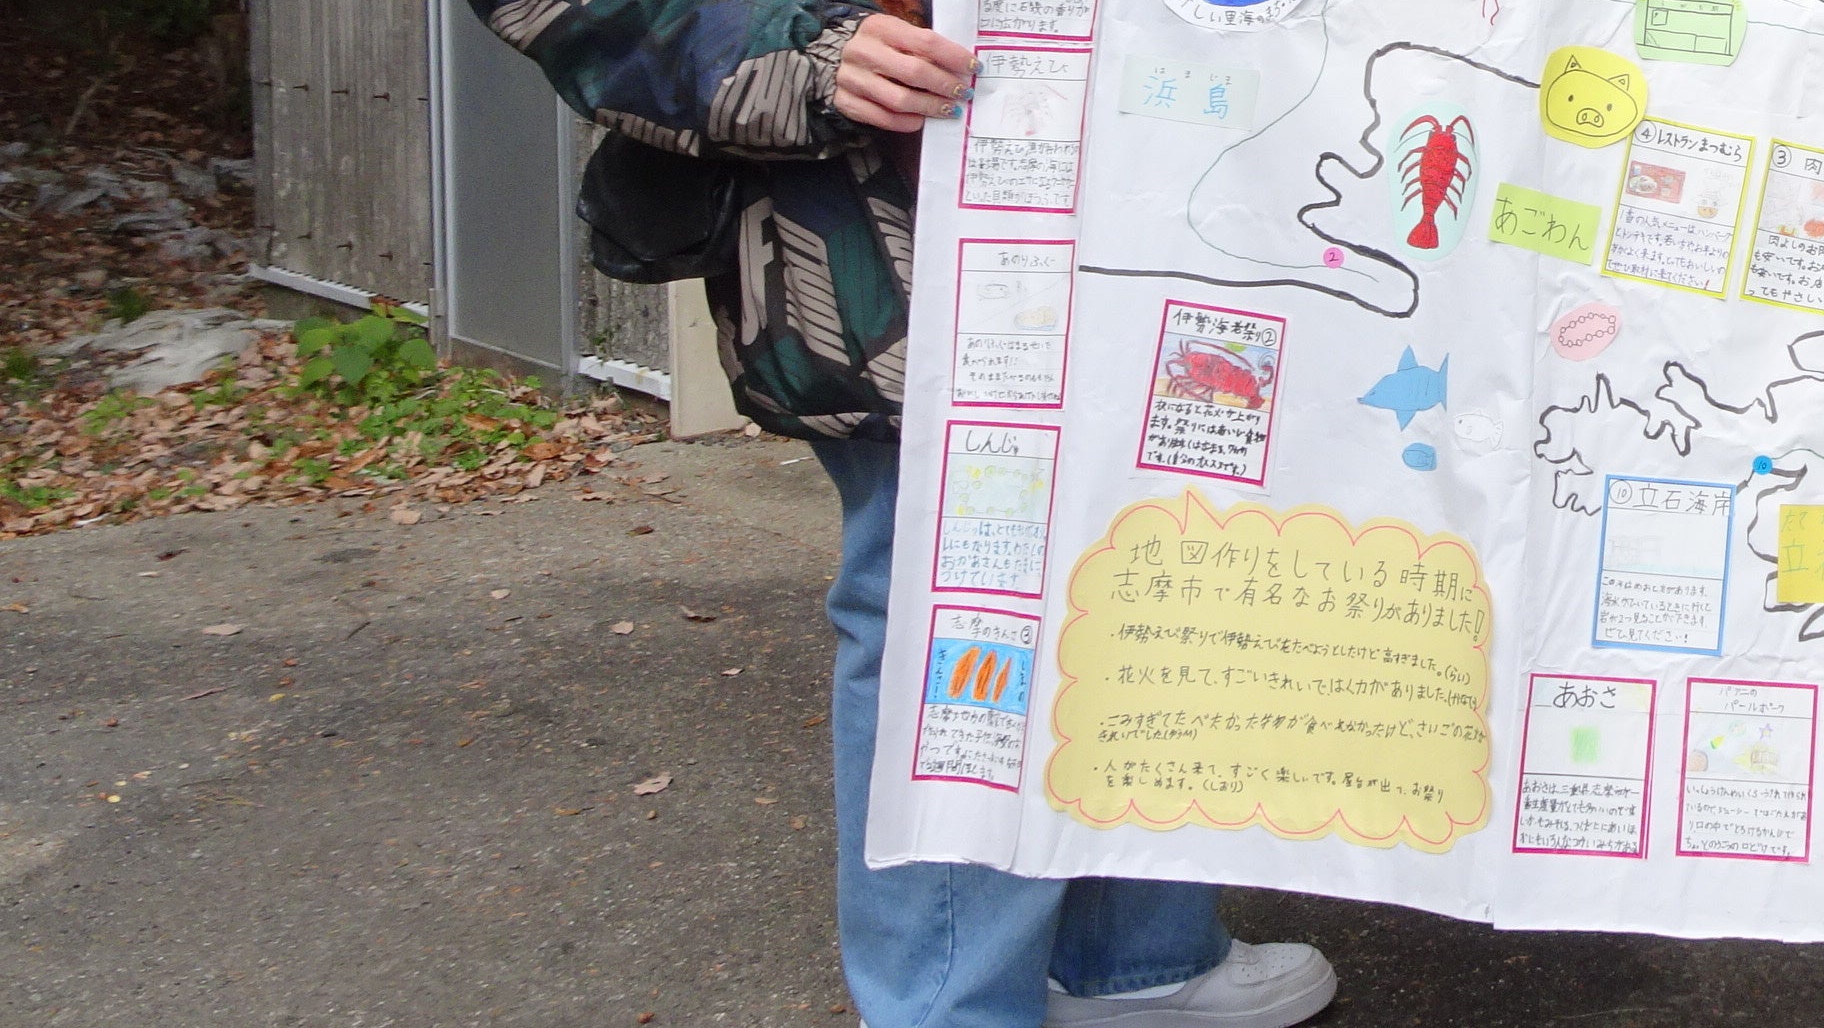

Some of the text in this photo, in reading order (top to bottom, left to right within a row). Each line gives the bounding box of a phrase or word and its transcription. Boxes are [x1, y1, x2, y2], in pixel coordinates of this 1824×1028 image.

[1143, 75, 1230, 121] 浜島
[1494, 197, 1590, 251] あごわん
[1632, 482, 1732, 517] 立石海岸
[1129, 534, 1473, 603] 地図作りをしている時期に
[1552, 680, 1617, 710] あおさ
